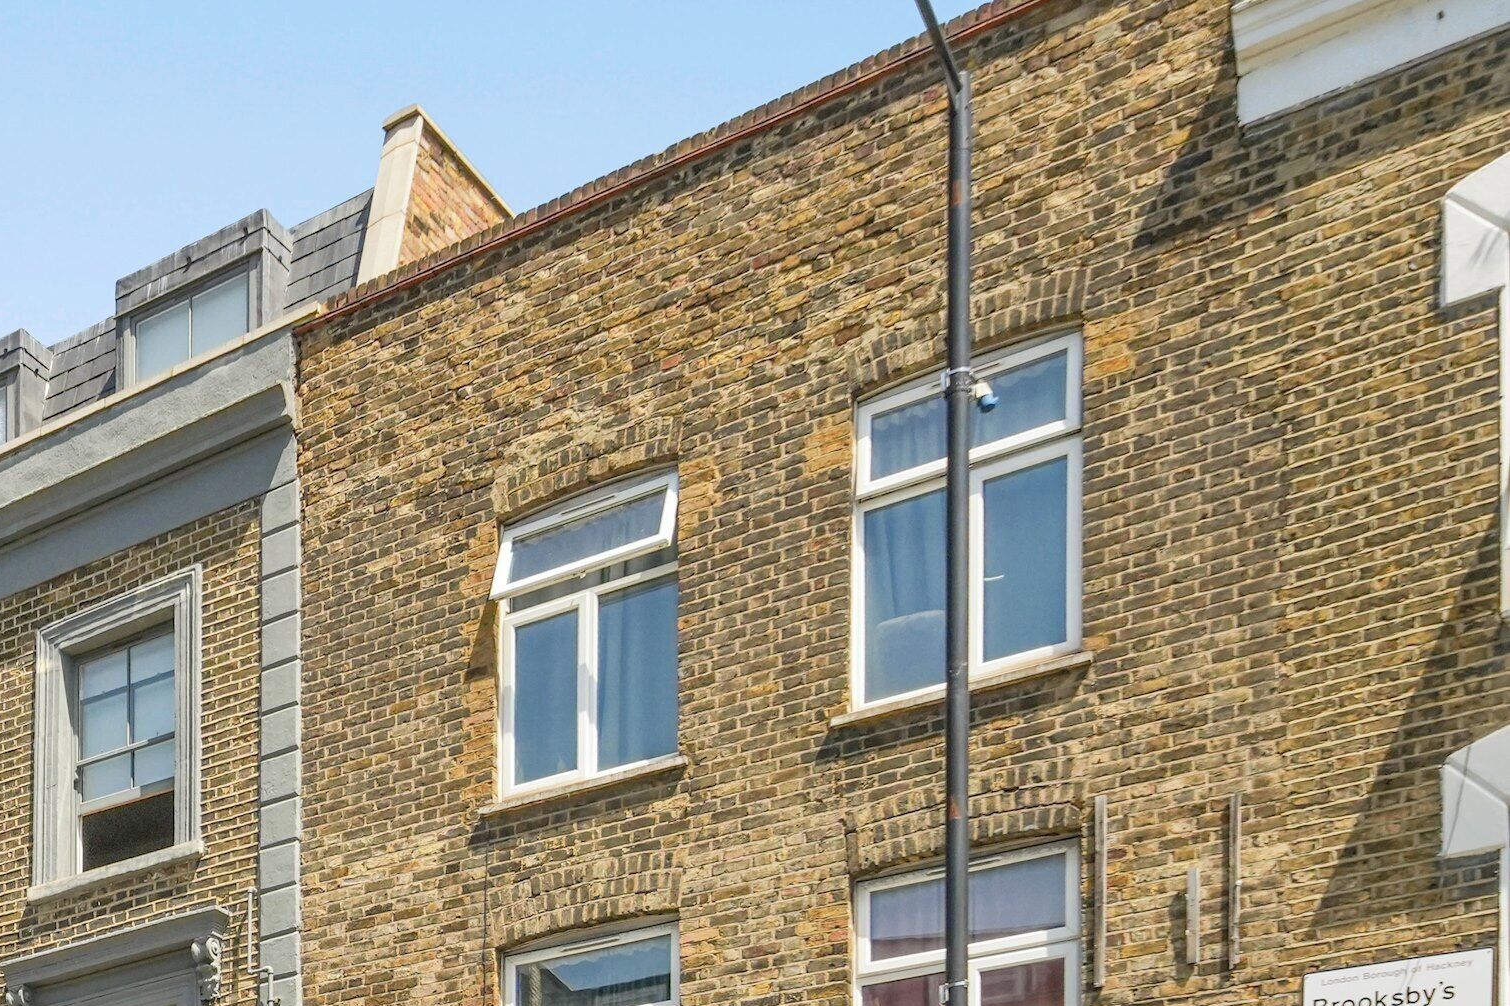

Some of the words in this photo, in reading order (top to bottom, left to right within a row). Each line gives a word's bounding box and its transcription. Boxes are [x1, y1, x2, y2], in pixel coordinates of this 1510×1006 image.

[1321, 974, 1359, 987] London
[1363, 968, 1407, 981] Borough
[1411, 966, 1422, 974] of
[1426, 959, 1474, 972] Hackney
